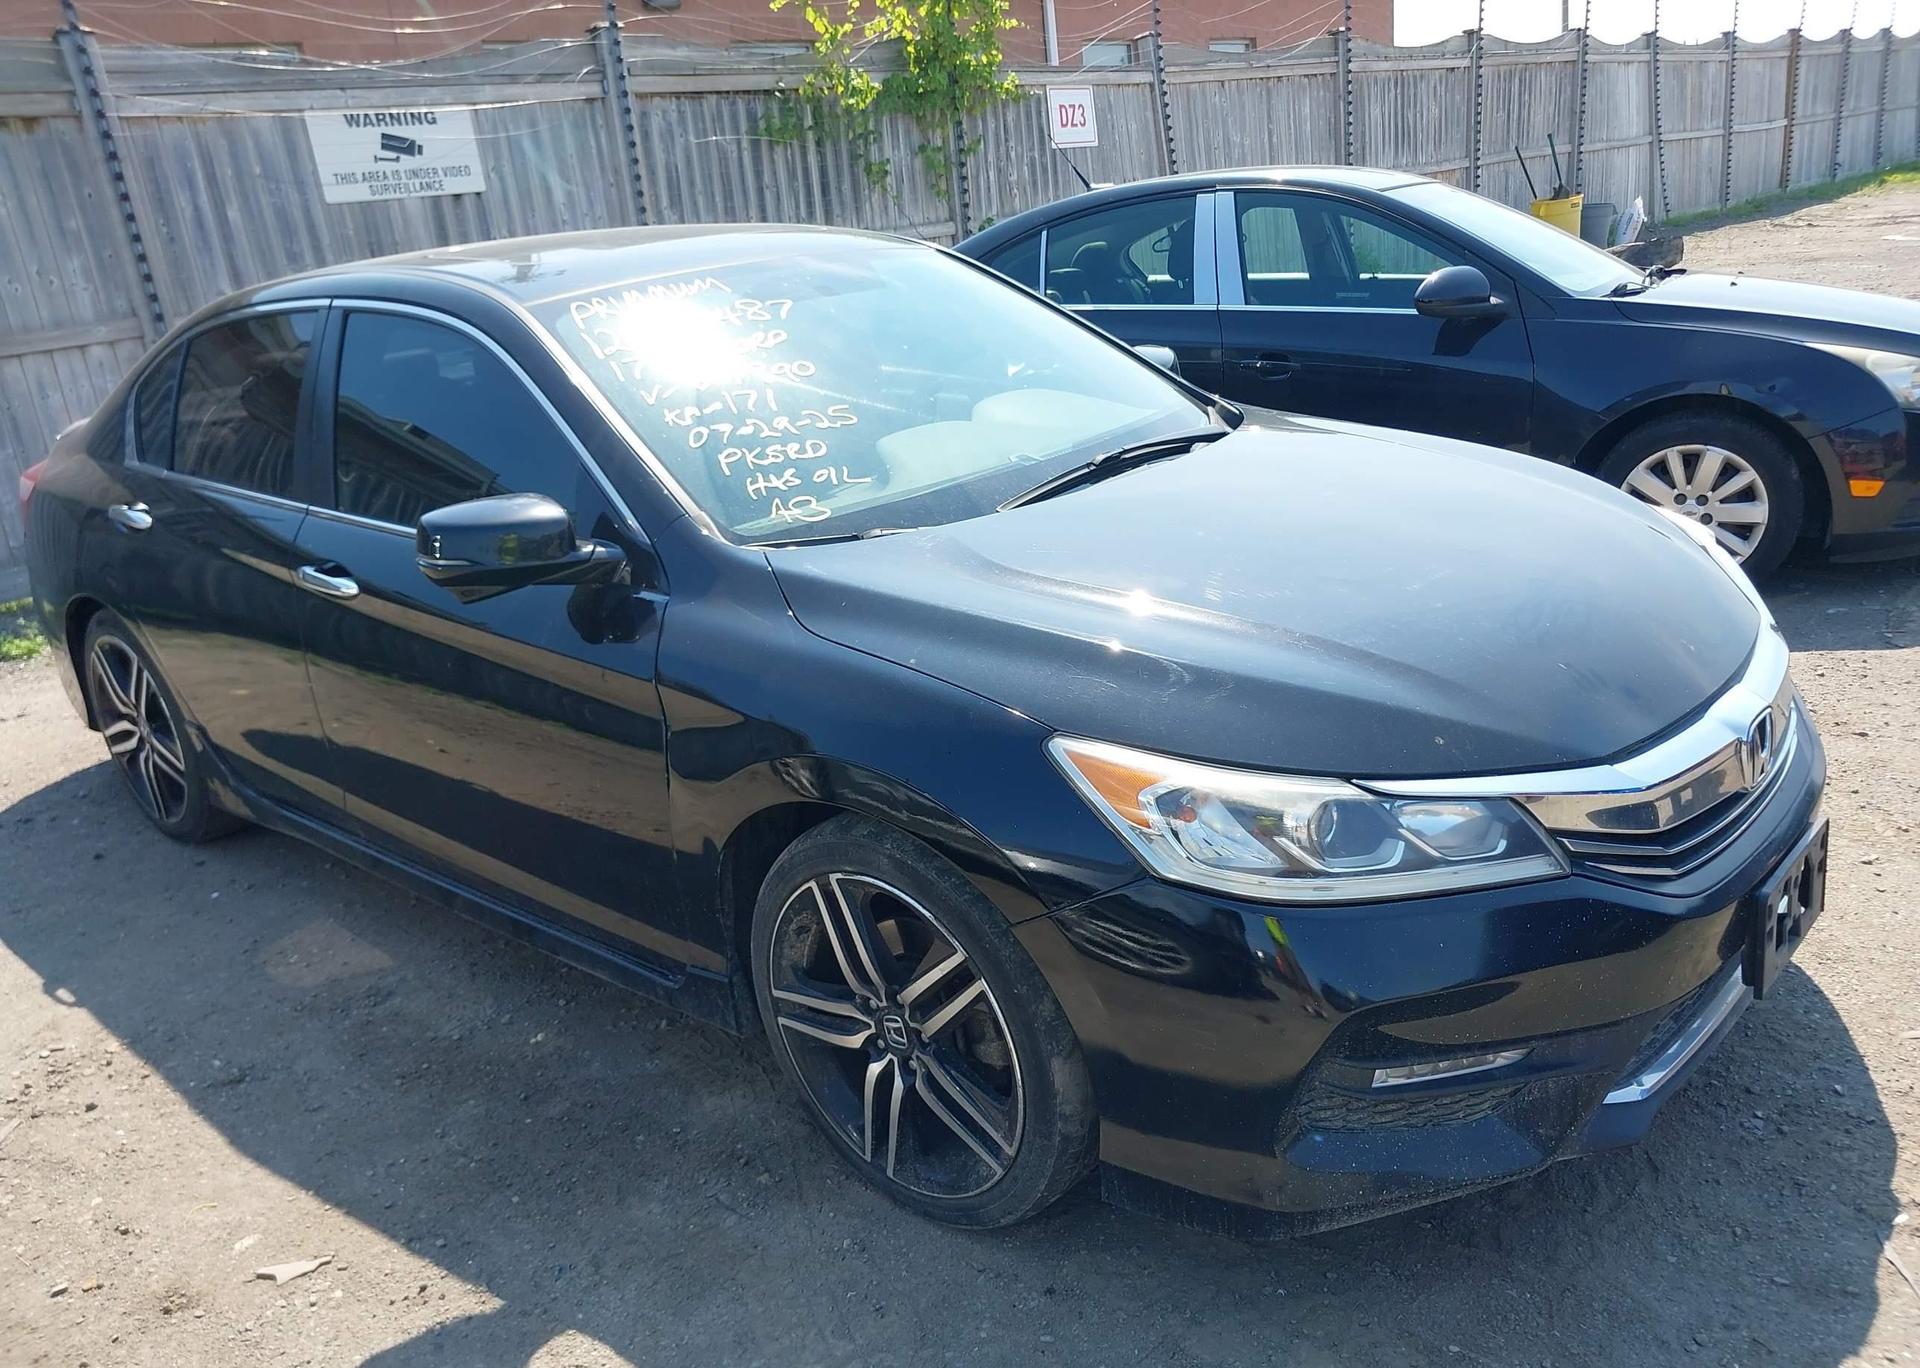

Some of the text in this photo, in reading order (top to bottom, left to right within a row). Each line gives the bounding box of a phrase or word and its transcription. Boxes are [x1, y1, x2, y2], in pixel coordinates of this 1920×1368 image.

[344, 111, 437, 128] WARNING
[1059, 104, 1086, 128] DZ3
[332, 165, 472, 185] THIS AREA IS UNDER VIDEO
[368, 180, 445, 197] SURVEILLANCE
[689, 404, 858, 448] 07-29-25
